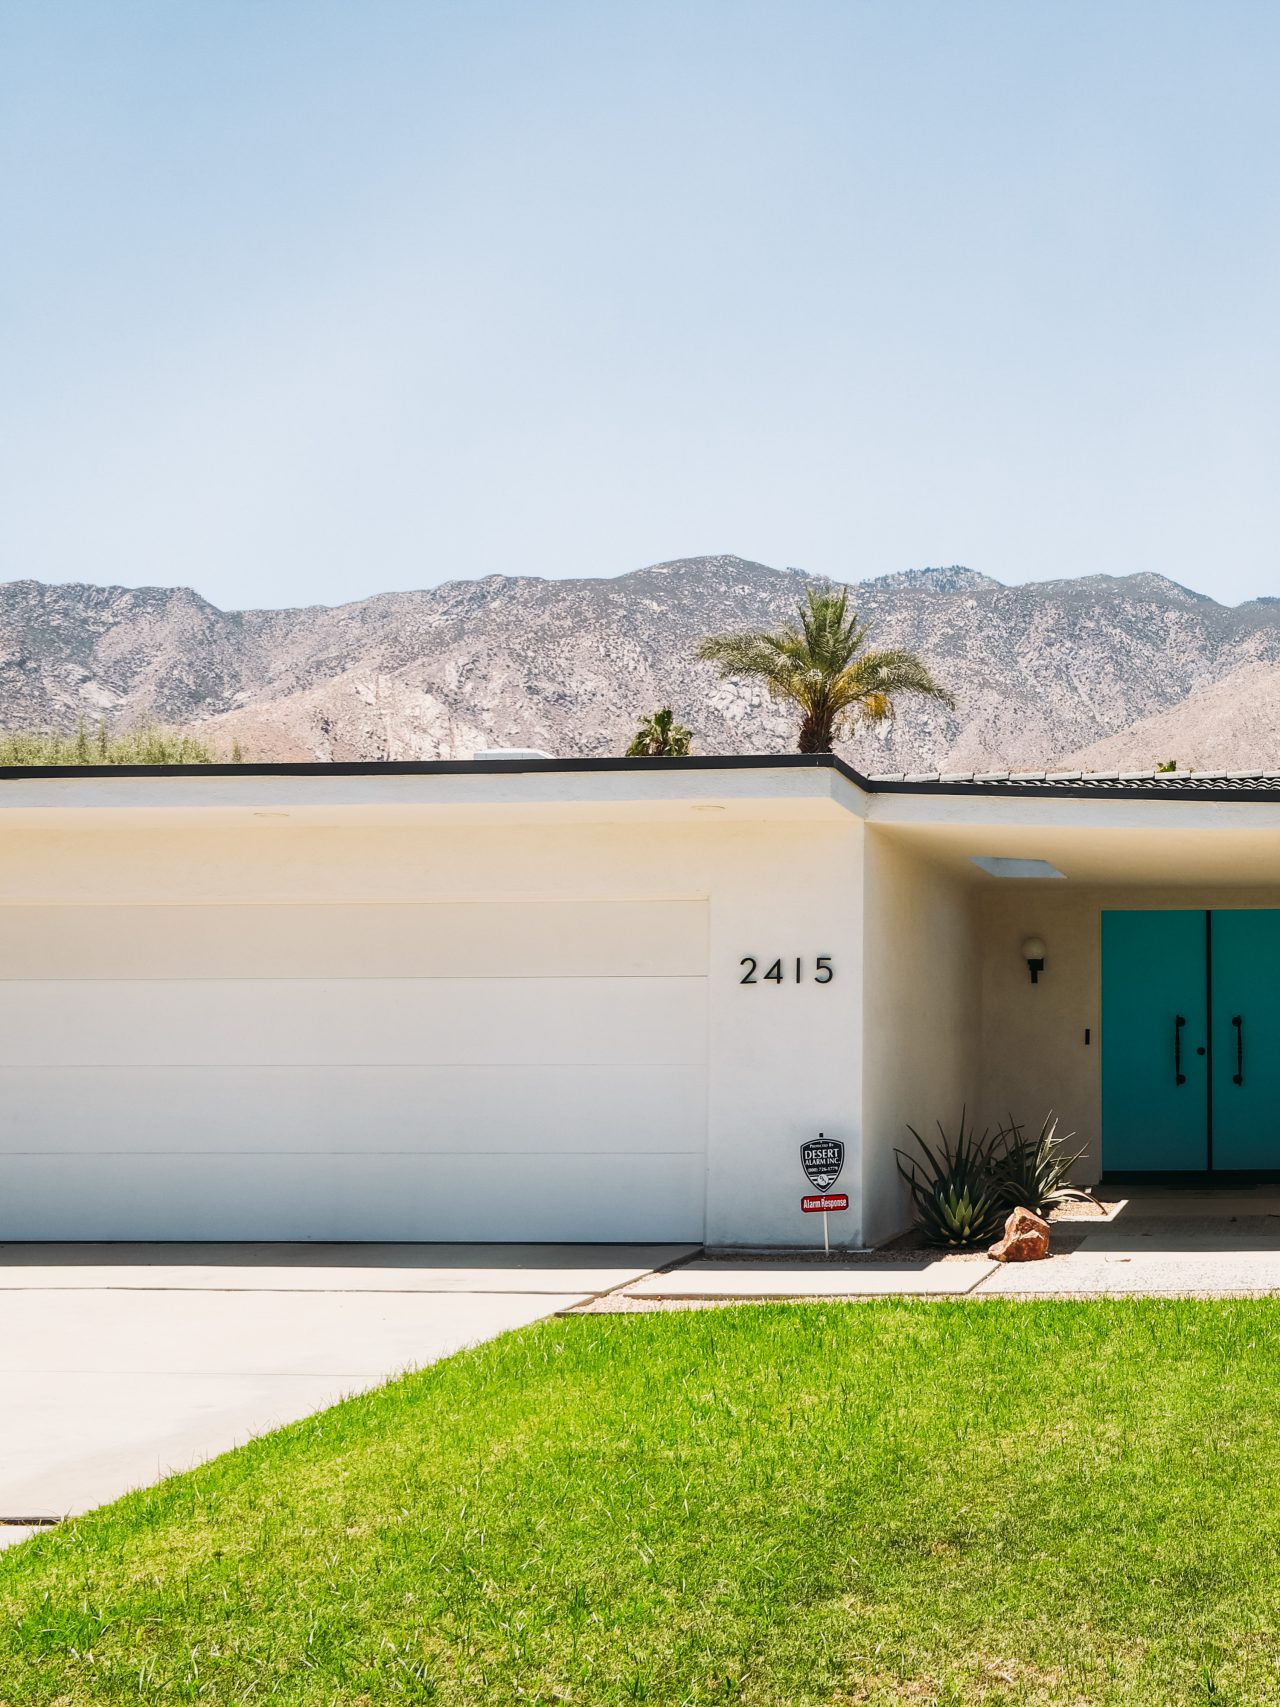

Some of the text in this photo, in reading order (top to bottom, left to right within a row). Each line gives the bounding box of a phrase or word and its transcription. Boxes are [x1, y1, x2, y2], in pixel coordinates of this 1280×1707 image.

[740, 957, 833, 984] 2415
[805, 1148, 839, 1159] DESERT
[803, 1199, 847, 1209] Alarm Response
